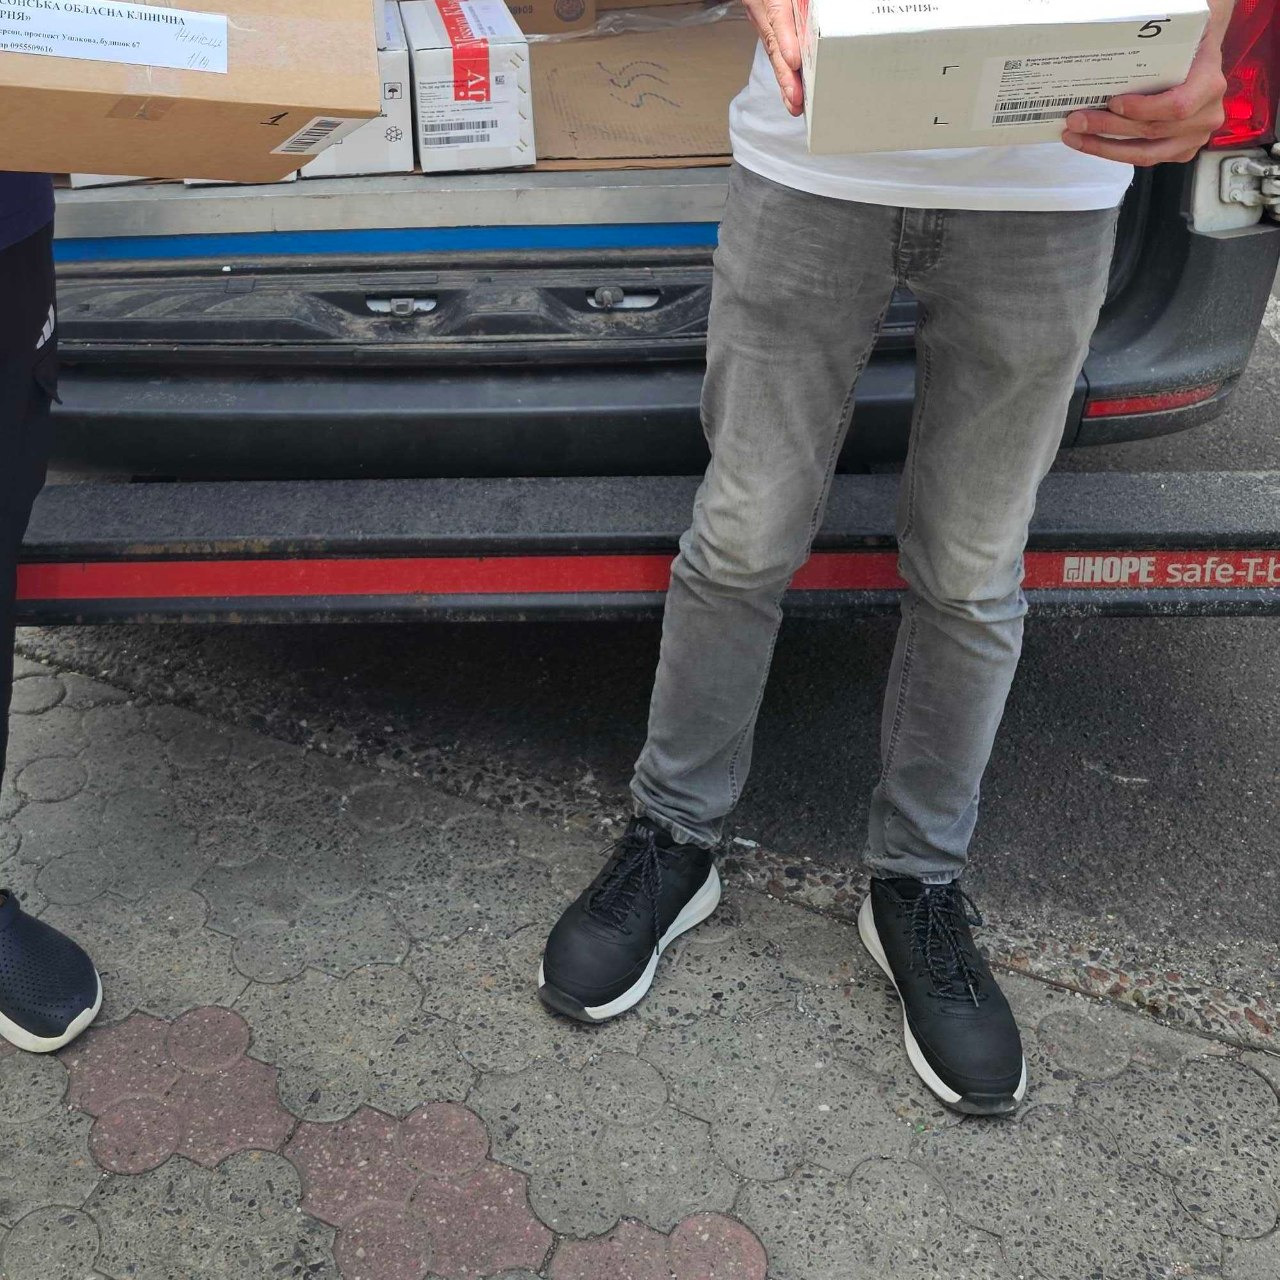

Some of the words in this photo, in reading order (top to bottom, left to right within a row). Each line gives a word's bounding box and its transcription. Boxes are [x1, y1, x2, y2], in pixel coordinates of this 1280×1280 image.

[63, 2, 123, 18] ОБЛАСНА
[127, 10, 185, 26] КЛІНІЧНА
[1137, 18, 1171, 38] 5
[1083, 556, 1156, 583] HOPE
